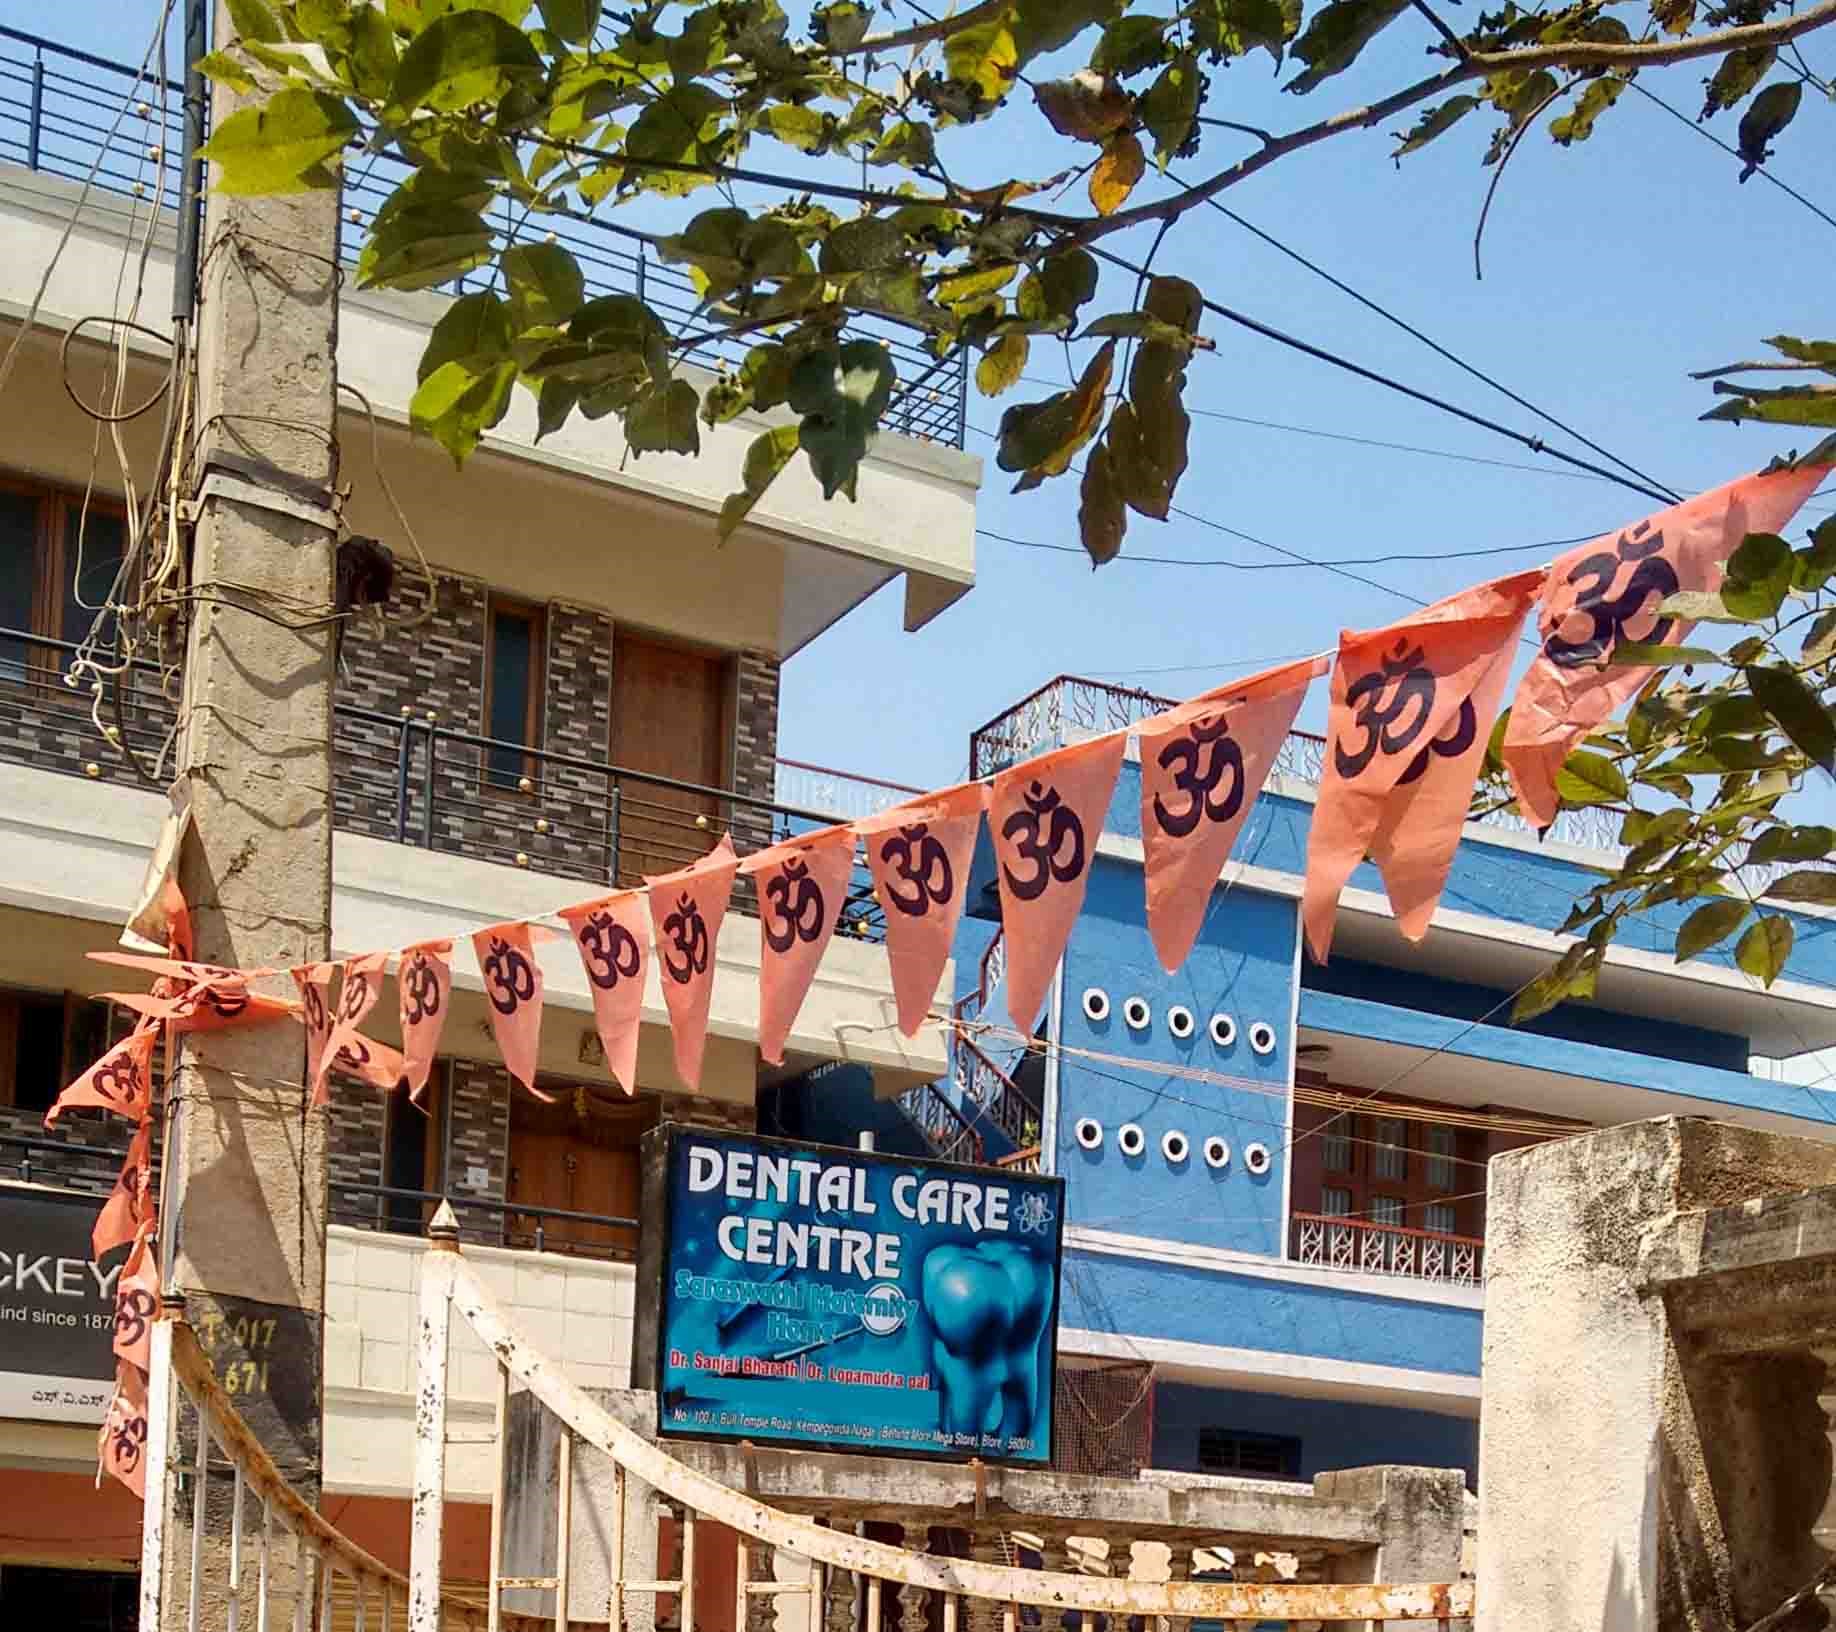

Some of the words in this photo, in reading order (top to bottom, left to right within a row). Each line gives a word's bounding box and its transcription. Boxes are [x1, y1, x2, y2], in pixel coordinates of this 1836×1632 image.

[688, 1145, 877, 1214] DENTAL
[891, 1174, 1010, 1233] CARE
[717, 1215, 901, 1281] CENTRE
[32, 1309, 76, 1327] since
[83, 1313, 117, 1330] 187
[768, 1311, 836, 1344] Home
[743, 1357, 798, 1378] Bharath
[829, 1366, 904, 1388] Lopamudra
[739, 1412, 769, 1429] Temple
